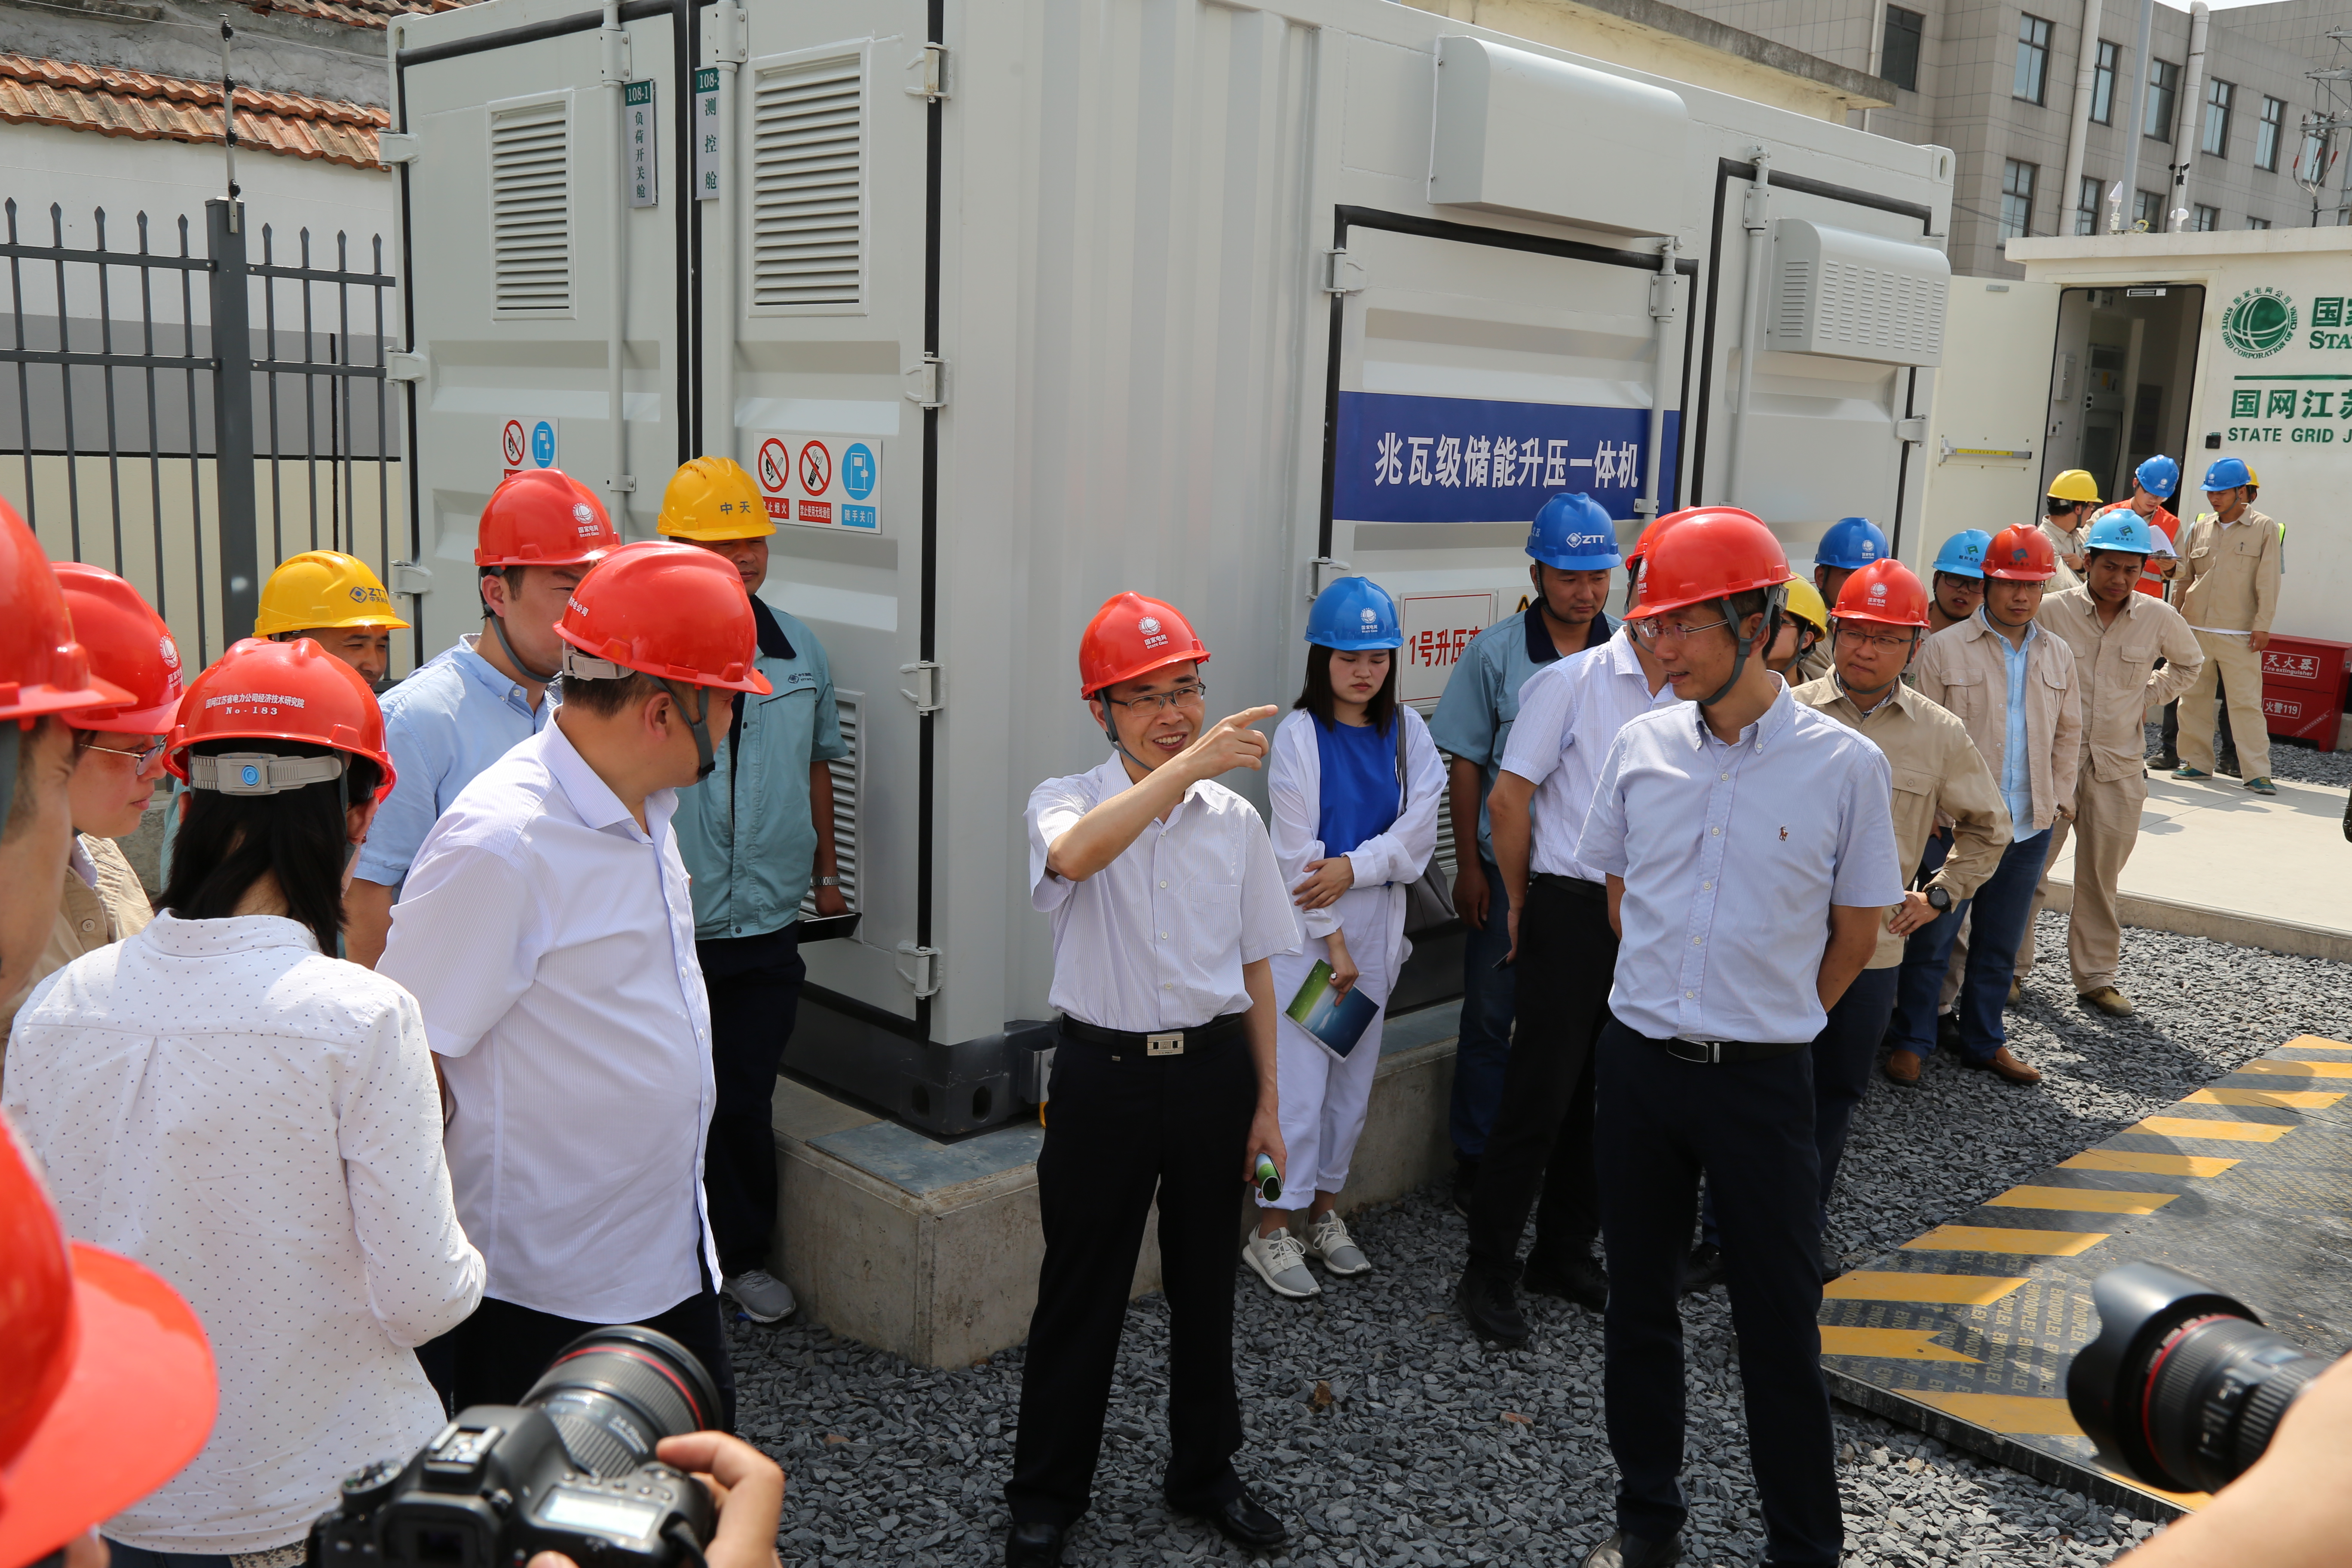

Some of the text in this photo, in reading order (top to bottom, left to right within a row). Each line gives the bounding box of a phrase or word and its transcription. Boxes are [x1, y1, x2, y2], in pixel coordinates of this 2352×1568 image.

[628, 86, 649, 101] 108-1
[704, 97, 717, 190] 测控舱
[634, 111, 646, 198] 负荷开关舱
[2233, 287, 2292, 306] 国家电网公司
[2311, 297, 2352, 327] 国
[2222, 306, 2297, 359] STATE GRID CORPORATION OF CHINA
[2228, 427, 2282, 442] STATE
[2291, 428, 2334, 443] GRID
[1375, 432, 1638, 489] 兆瓦级储能升压一体机
[720, 501, 751, 515] 中天
[799, 505, 830, 519] 禁止使用无线通信
[845, 509, 873, 524] 随手关门
[578, 525, 599, 533] 国家电网
[1582, 535, 1605, 544] ZTT
[368, 588, 387, 598] ZTT
[1144, 634, 1167, 646] 国家电网
[2265, 655, 2314, 670] 灭火器
[2275, 668, 2313, 677] extinguisher
[205, 693, 305, 709] 国网江苏省电力公司经济技术研究院
[2265, 701, 2298, 715] 火警119
[2020, 1283, 2041, 1332] EWOODPLEX
[2045, 1287, 2065, 1338] EWOODPLEX
[2070, 1293, 2089, 1343] EWOODPLEX
[1984, 1332, 2009, 1385] EWOODPLEX
[2011, 1337, 2034, 1392] EWOODPLEX
[2038, 1342, 2060, 1398] EWOODPLEX
